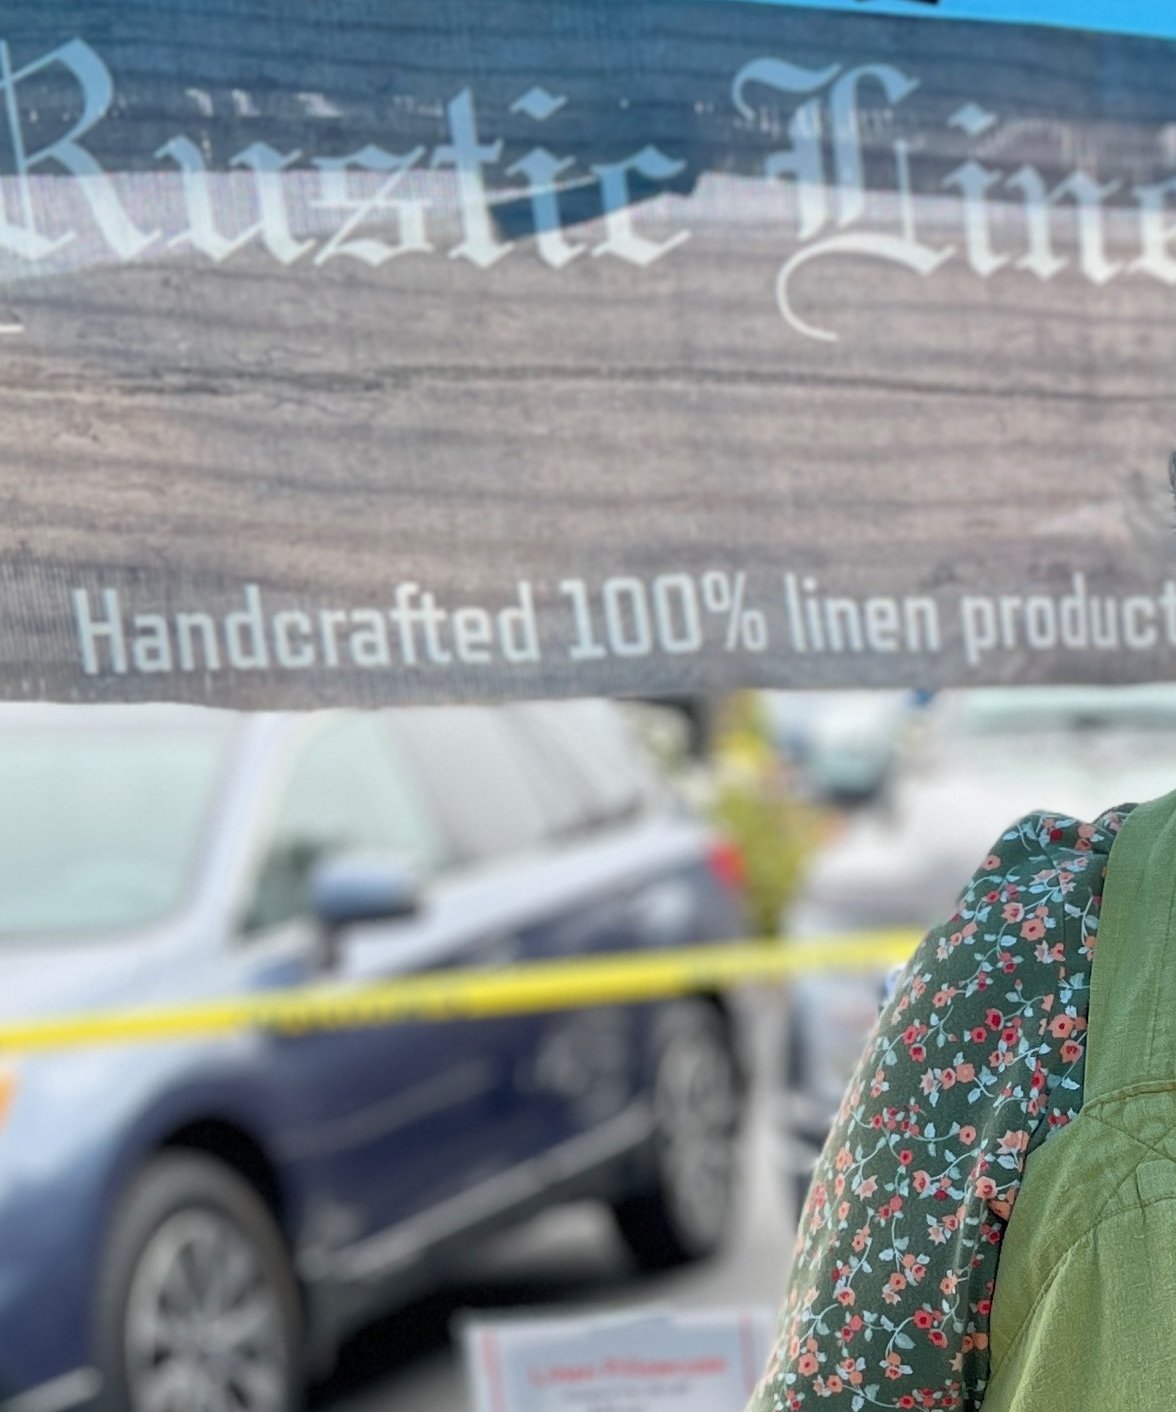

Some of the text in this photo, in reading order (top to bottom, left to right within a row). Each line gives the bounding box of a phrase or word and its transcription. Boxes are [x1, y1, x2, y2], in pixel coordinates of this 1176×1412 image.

[0, 37, 691, 268] Rustic
[72, 581, 540, 676] Handcrafted
[559, 571, 767, 660] 100%
[786, 572, 943, 653] linen
